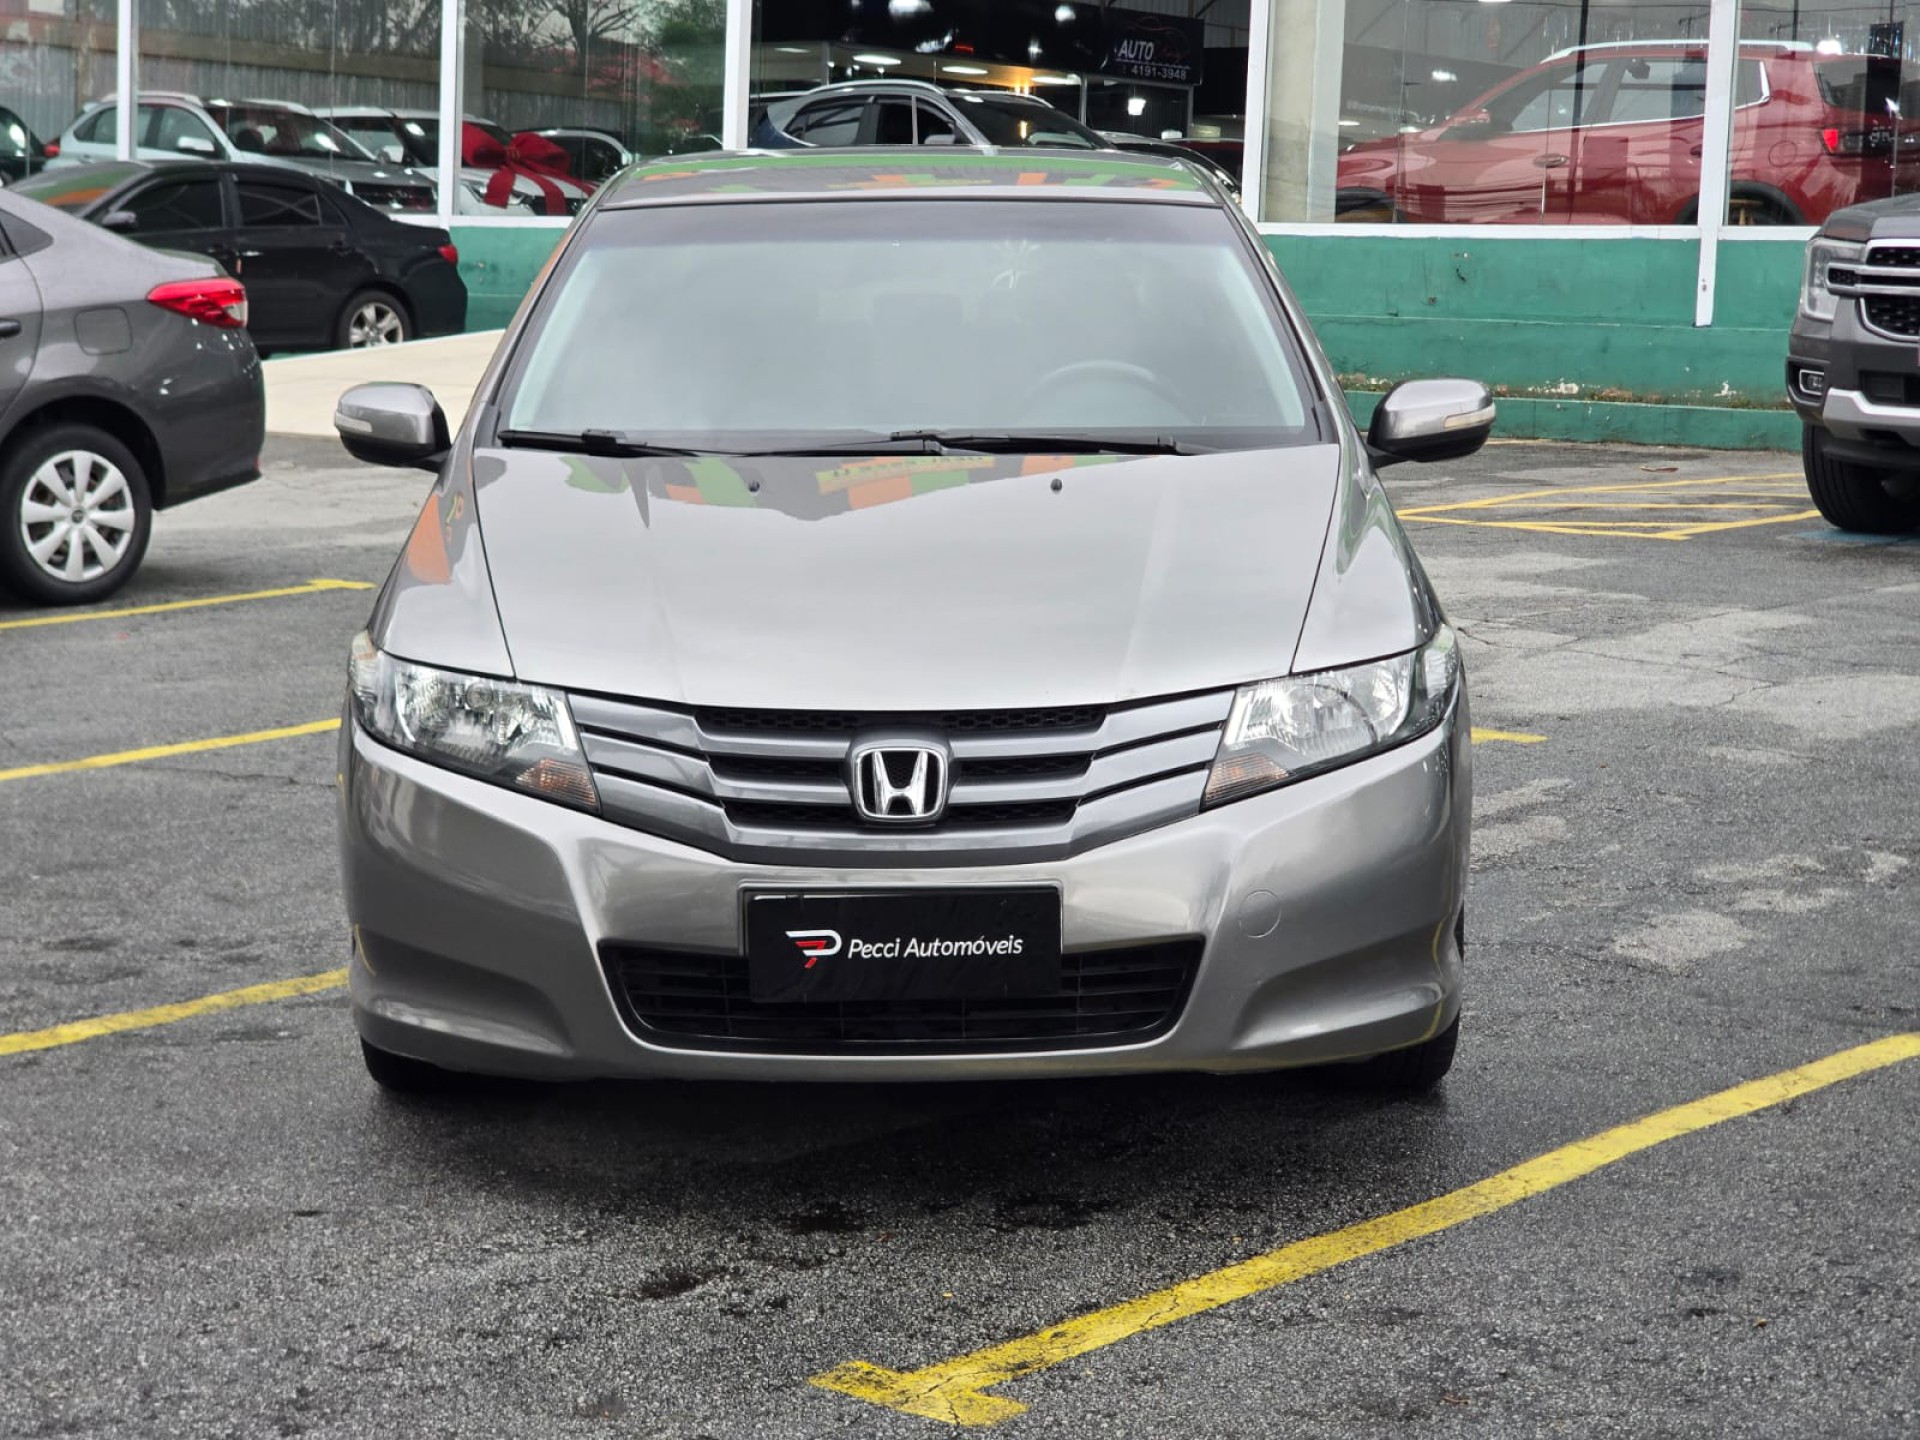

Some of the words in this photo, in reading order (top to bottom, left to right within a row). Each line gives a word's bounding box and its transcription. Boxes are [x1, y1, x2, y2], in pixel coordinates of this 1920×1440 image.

[1118, 39, 1155, 60] AUTO
[848, 937, 900, 959] Pecci
[904, 934, 1024, 958] Automóveis
